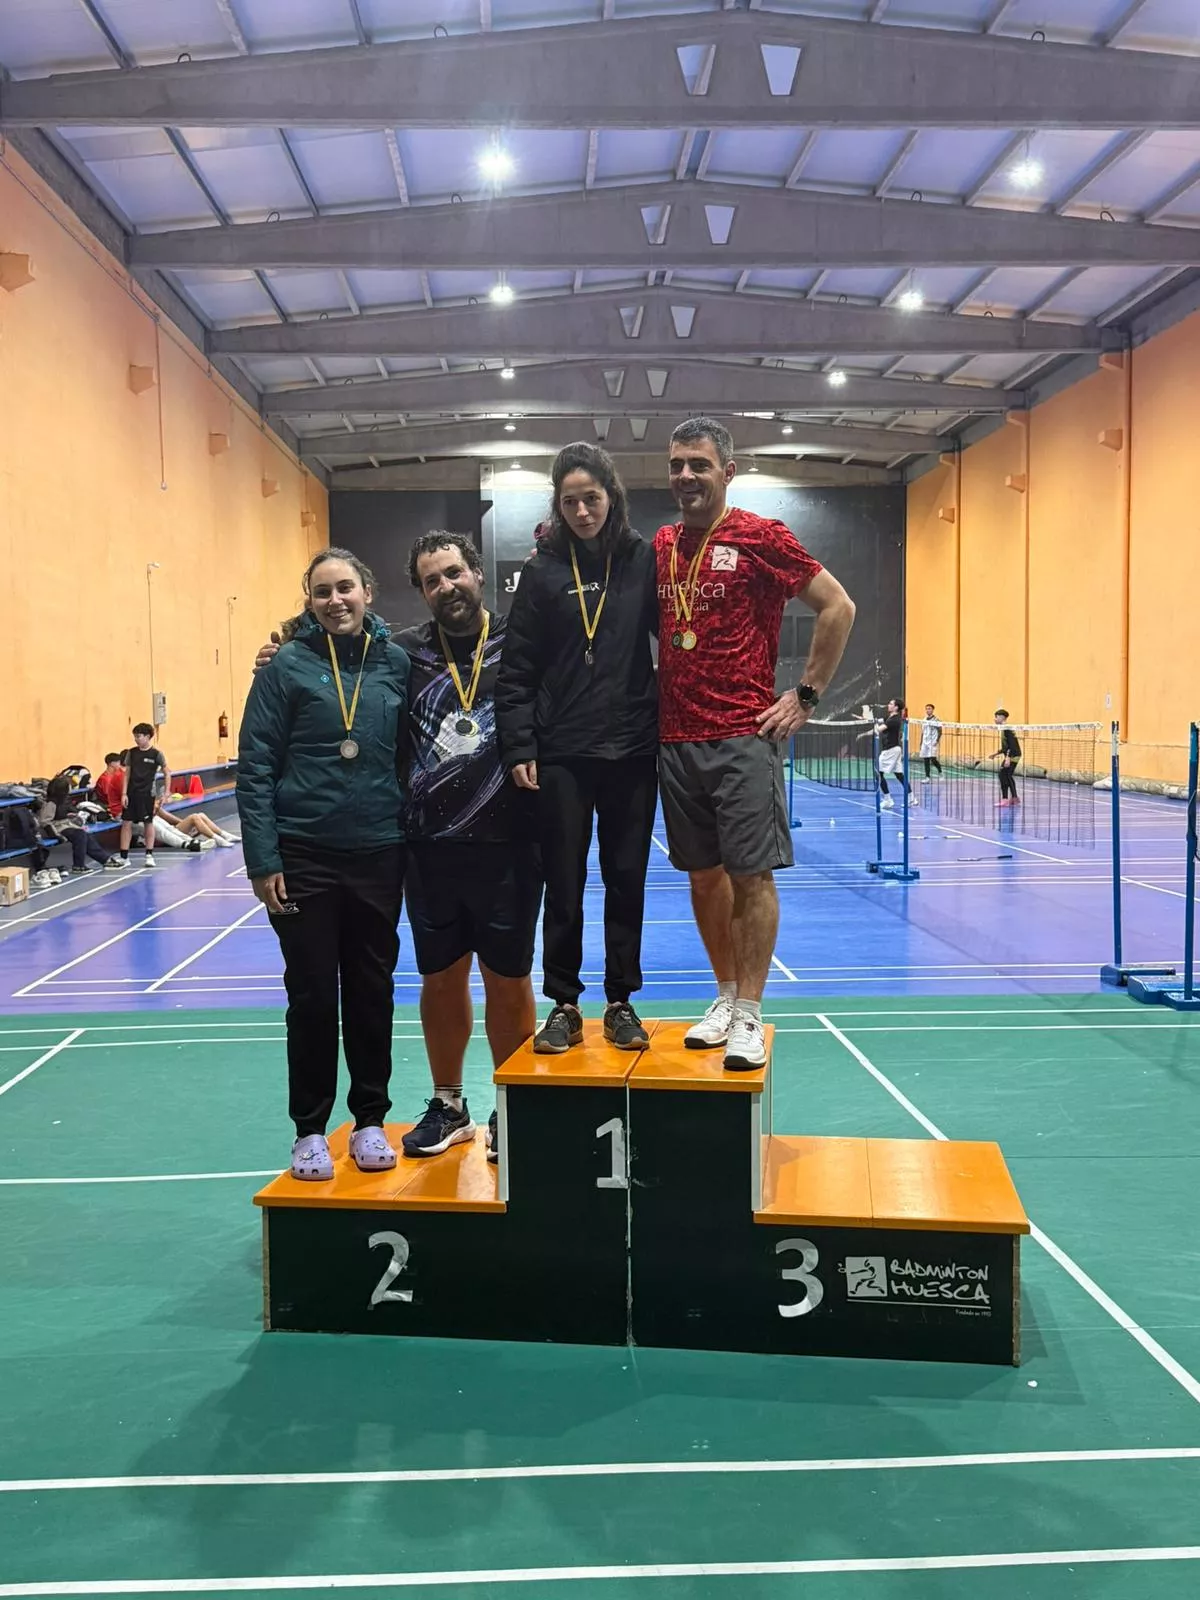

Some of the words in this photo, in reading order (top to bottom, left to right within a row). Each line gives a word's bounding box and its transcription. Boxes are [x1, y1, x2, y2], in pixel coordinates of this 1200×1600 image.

[596, 1117, 629, 1189] 1
[367, 1230, 414, 1307] 2
[775, 1238, 824, 1318] 3
[890, 1279, 990, 1304] HUESCA
